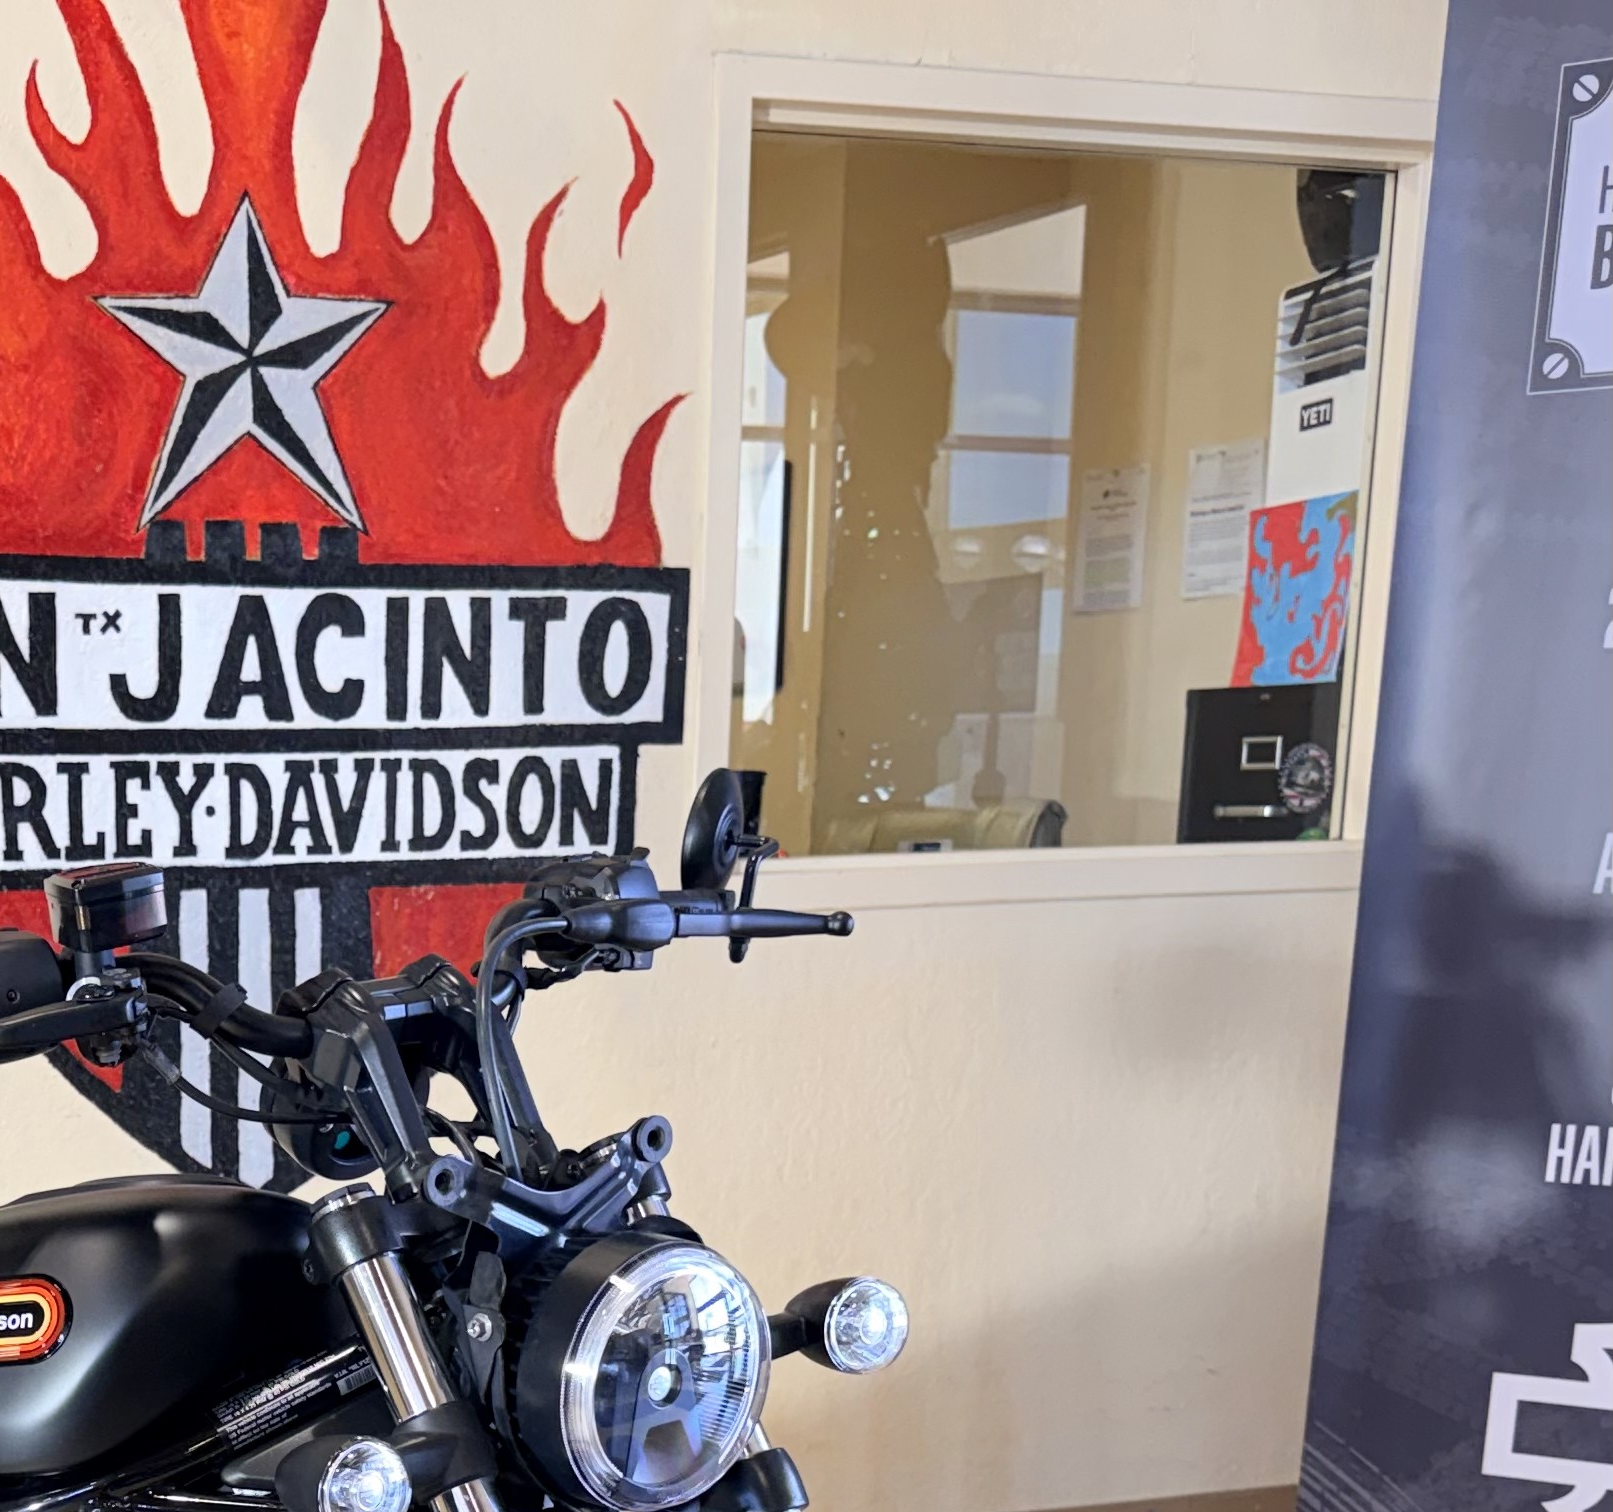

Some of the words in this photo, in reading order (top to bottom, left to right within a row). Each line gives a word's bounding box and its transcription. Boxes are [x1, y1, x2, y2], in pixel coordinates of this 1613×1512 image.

[1300, 402, 1331, 428] YETI
[75, 608, 122, 635] TX
[109, 592, 653, 722] JACINTO
